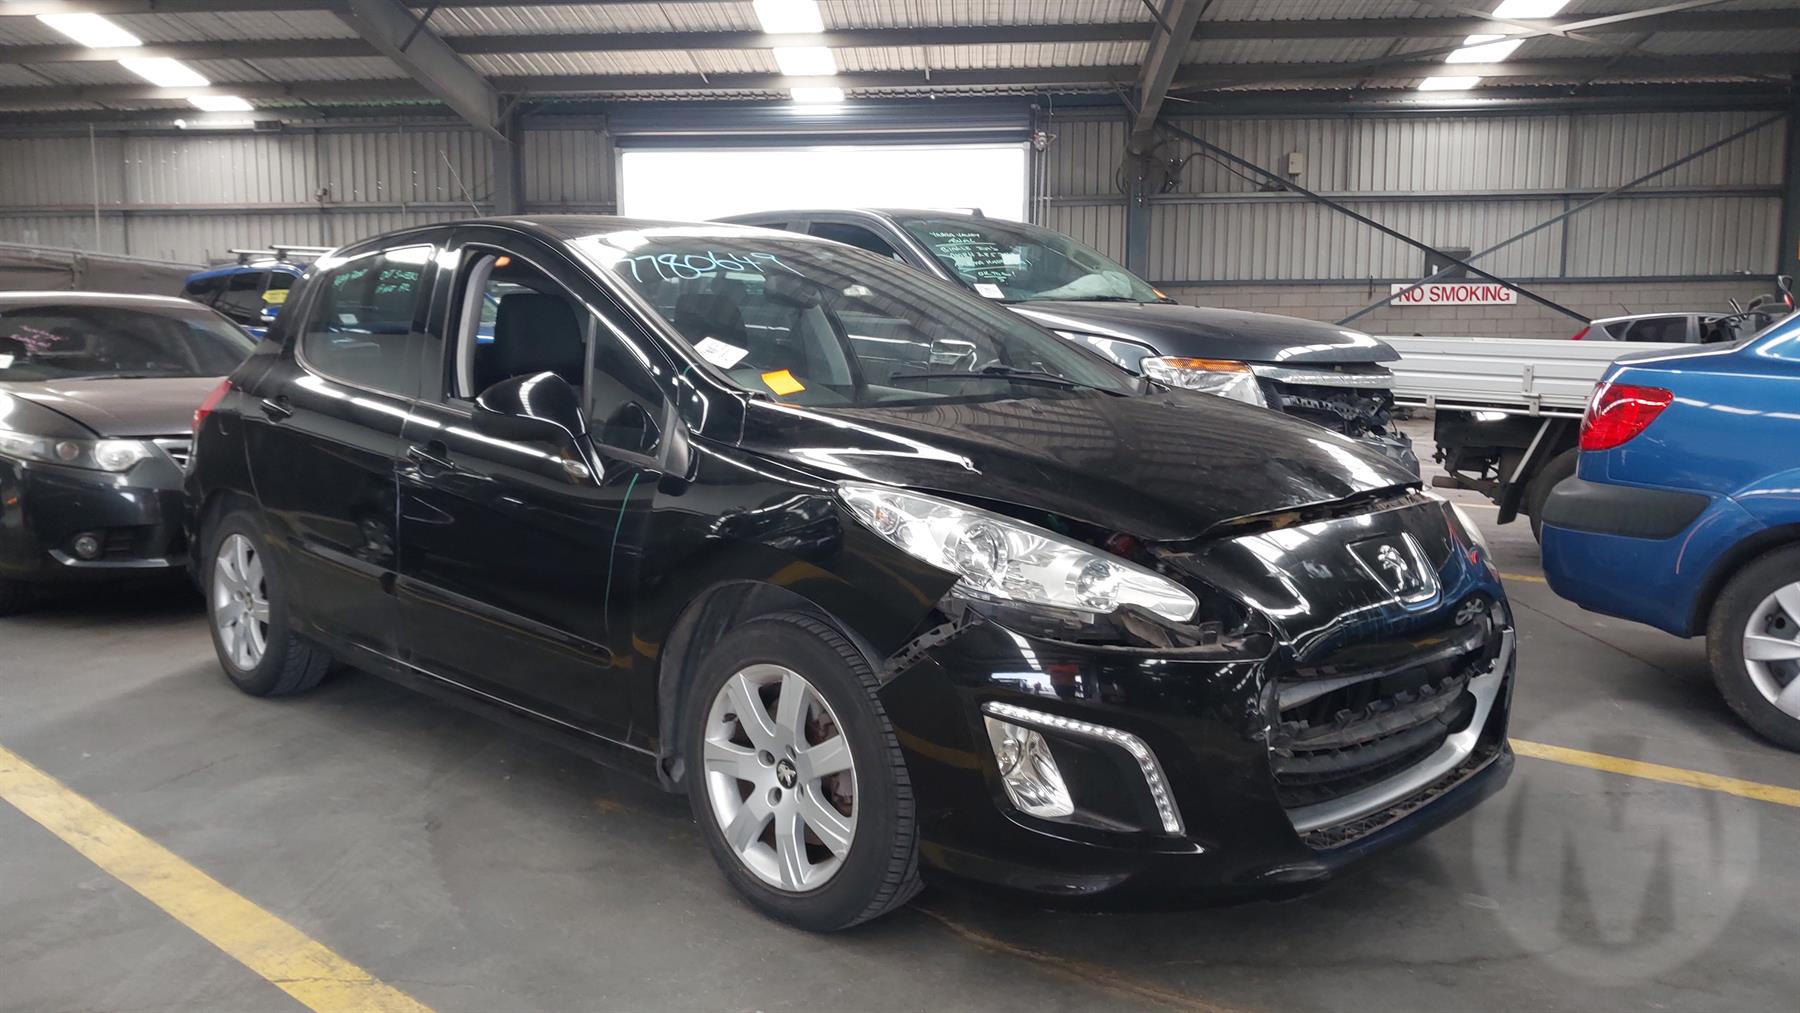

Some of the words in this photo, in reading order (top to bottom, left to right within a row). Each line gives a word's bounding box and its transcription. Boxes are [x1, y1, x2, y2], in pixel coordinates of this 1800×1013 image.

[615, 250, 806, 283] 7780649
[1398, 285, 1425, 303] NO
[1429, 285, 1511, 303] SMOKING
